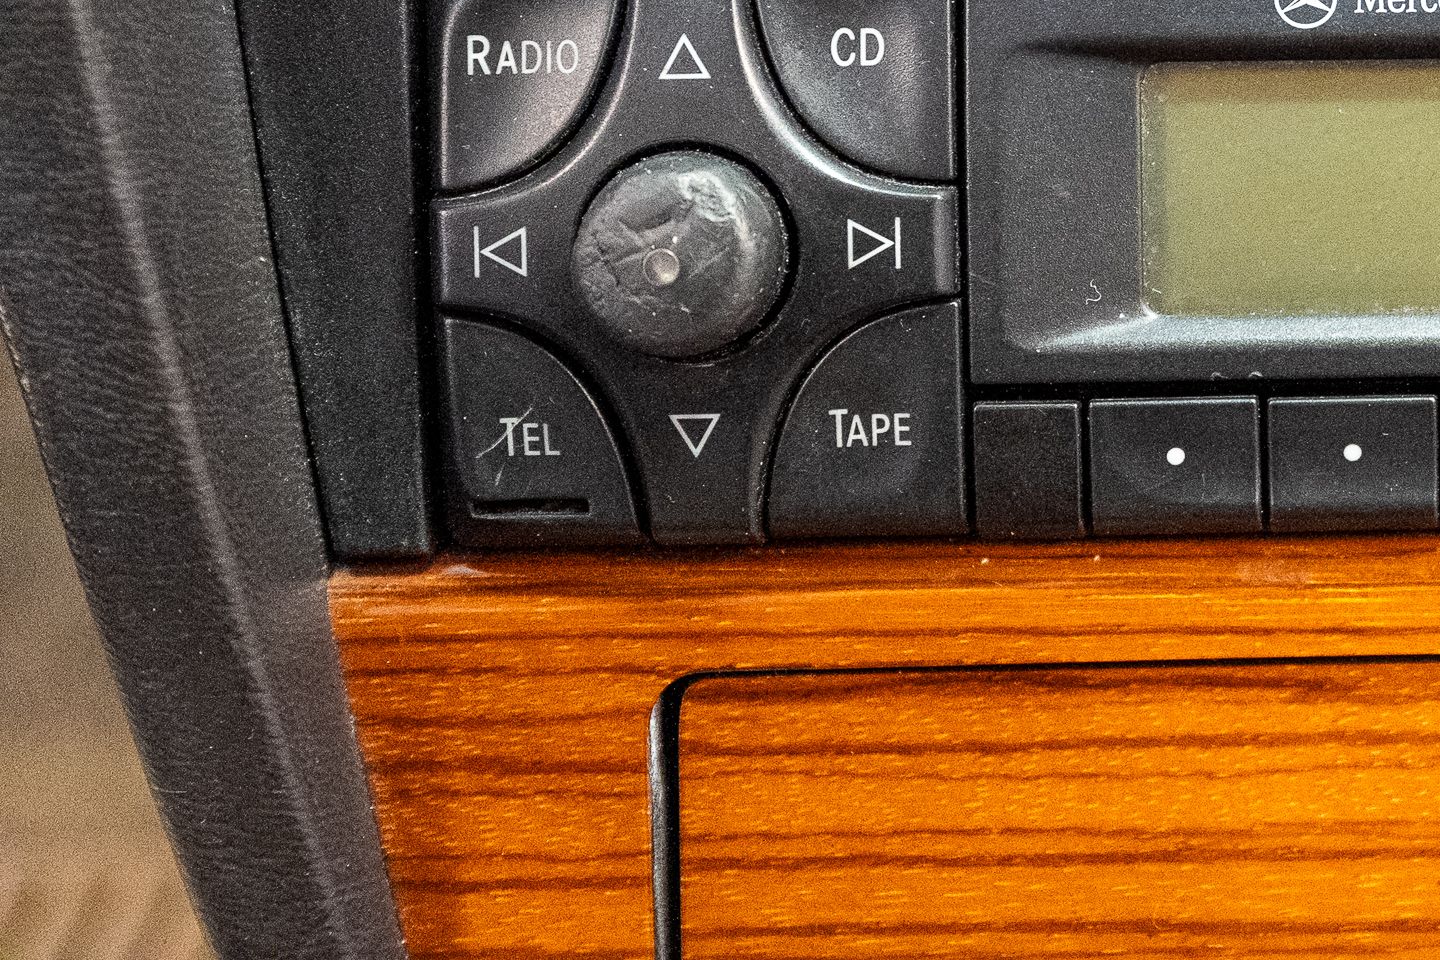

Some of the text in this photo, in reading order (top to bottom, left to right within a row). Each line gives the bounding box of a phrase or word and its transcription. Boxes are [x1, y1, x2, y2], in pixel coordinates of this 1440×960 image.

[466, 34, 579, 76] RADIO
[830, 27, 885, 67] CD
[499, 416, 561, 457] TEL
[829, 408, 912, 448] TAPE
